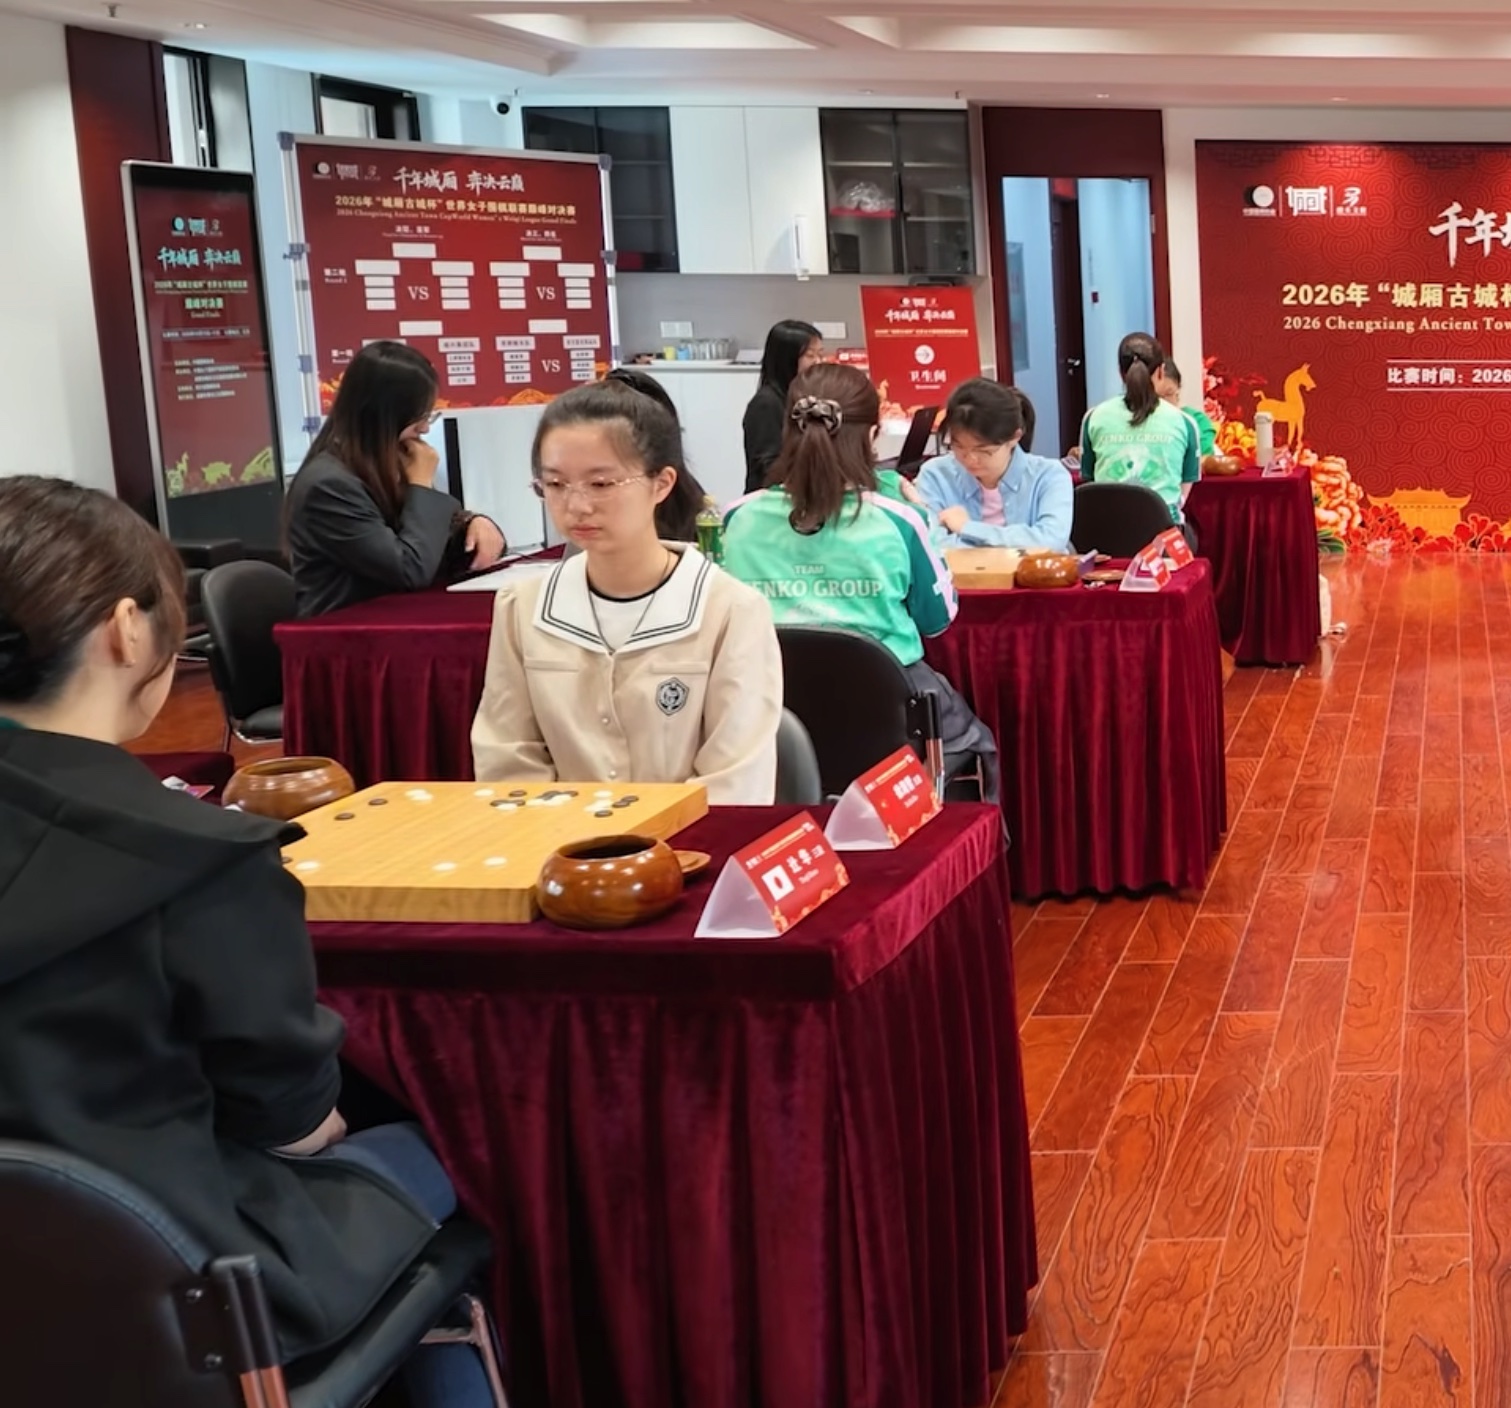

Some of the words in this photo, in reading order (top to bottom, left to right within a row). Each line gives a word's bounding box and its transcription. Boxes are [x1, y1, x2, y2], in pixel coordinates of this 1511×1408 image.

[408, 286, 429, 300] VS
[536, 286, 556, 300] VS
[1284, 316, 1321, 330] 2026
[1325, 315, 1415, 334] Chengxiang
[1418, 316, 1478, 331] Ancient
[541, 359, 560, 373] VS
[794, 565, 825, 574] TEAM
[750, 579, 807, 598] ENKO
[813, 579, 882, 598] GROUP
